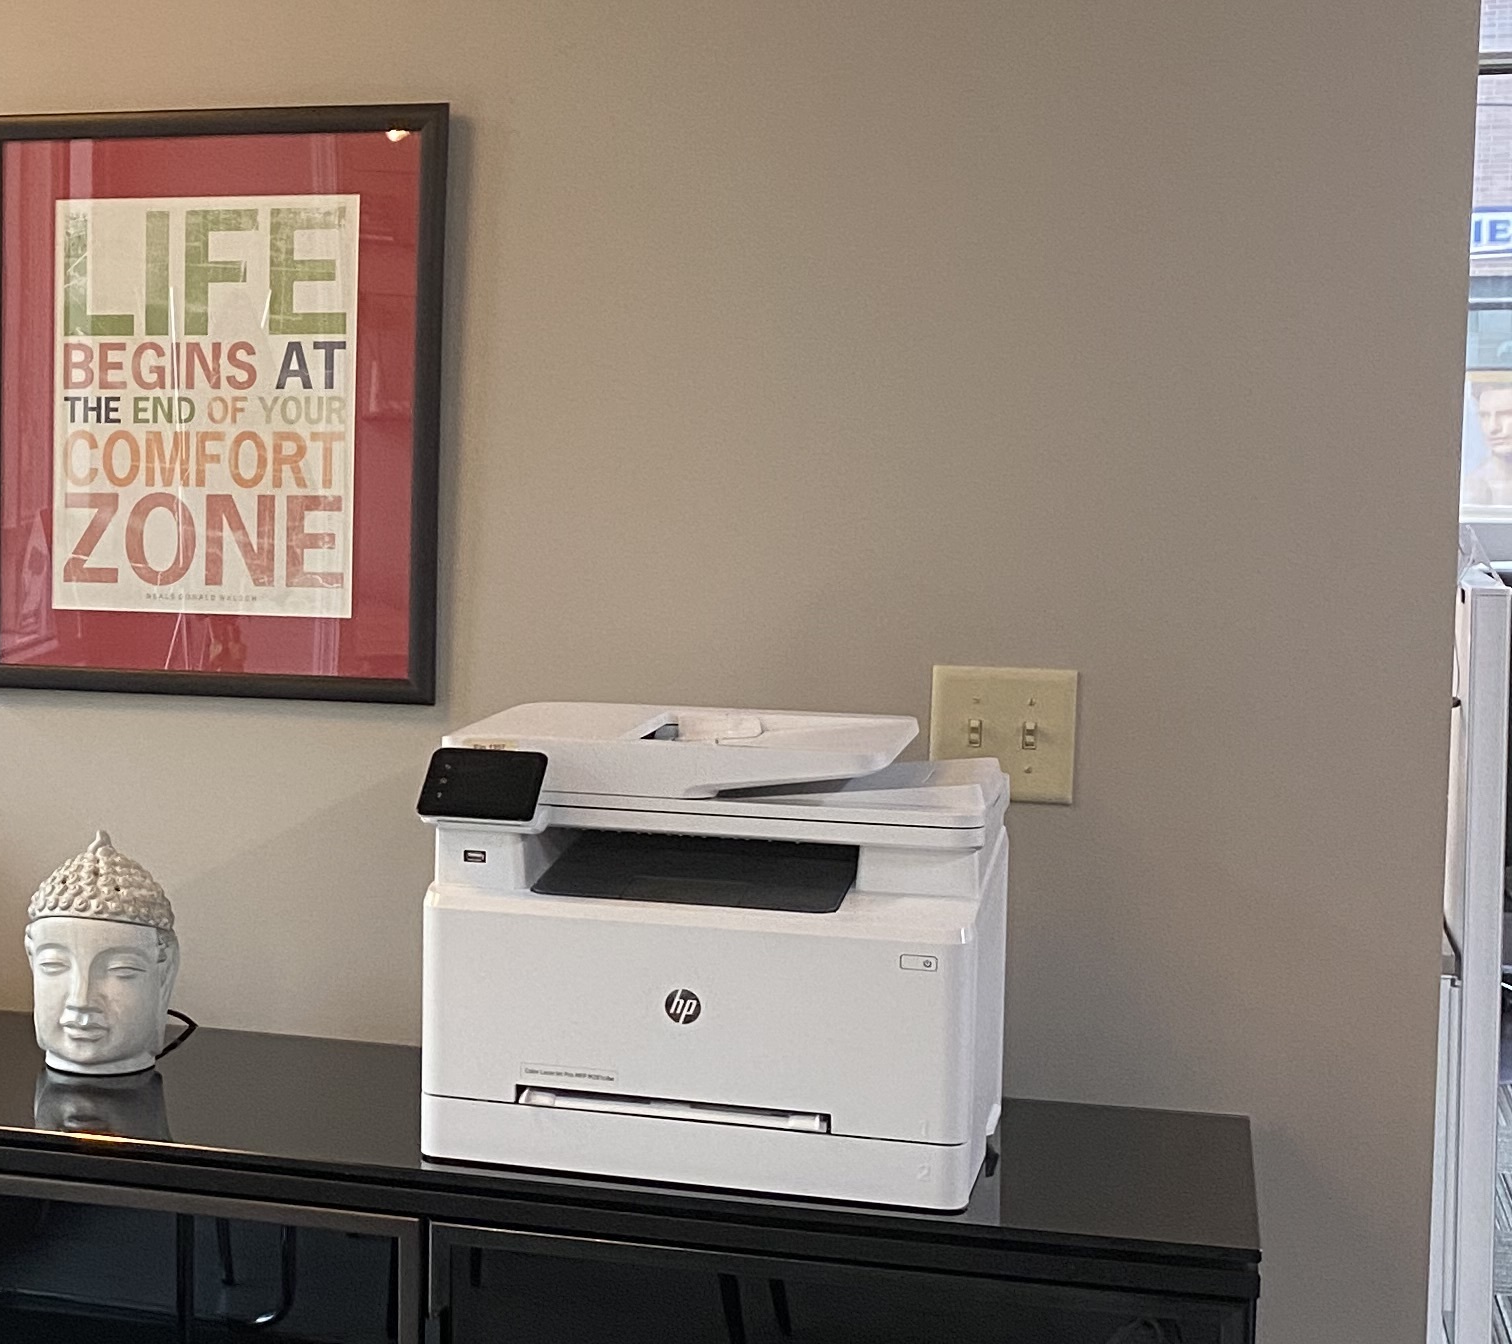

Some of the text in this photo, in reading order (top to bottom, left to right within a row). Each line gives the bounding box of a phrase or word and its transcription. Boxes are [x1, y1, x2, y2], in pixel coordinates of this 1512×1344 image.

[63, 206, 347, 337] LIFE
[62, 340, 347, 391] BEGINS AT
[63, 395, 346, 426] THE END OF YOUR
[62, 429, 346, 490] COMFORT
[62, 491, 345, 589] ZONE
[666, 988, 701, 1025] hp
